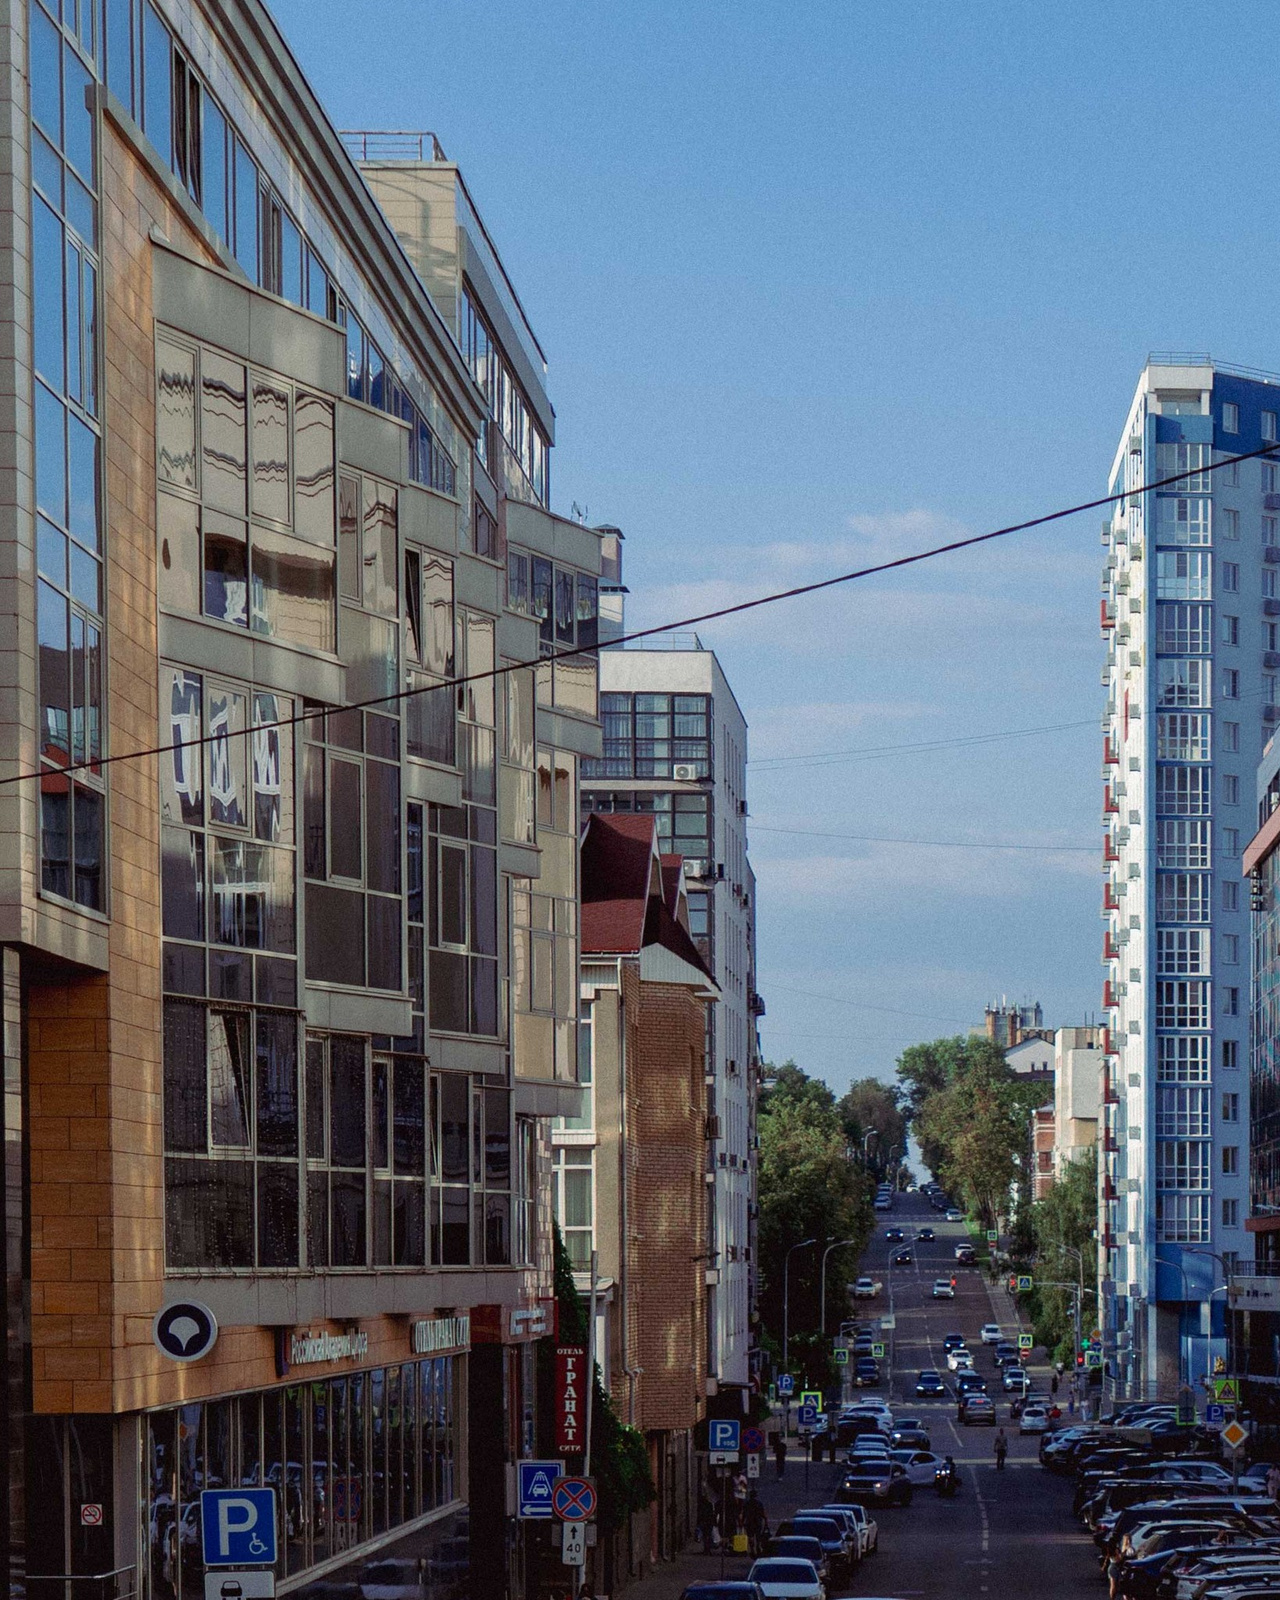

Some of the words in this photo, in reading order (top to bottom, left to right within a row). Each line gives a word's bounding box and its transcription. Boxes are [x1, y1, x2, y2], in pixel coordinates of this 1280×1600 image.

[556, 1347, 584, 1356] ОТЕЛЬ
[563, 1357, 578, 1442] ГРАНАТ
[1211, 1406, 1221, 1421] P
[716, 1423, 733, 1447] P
[218, 1498, 258, 1556] P
[566, 1543, 581, 1554] 40
